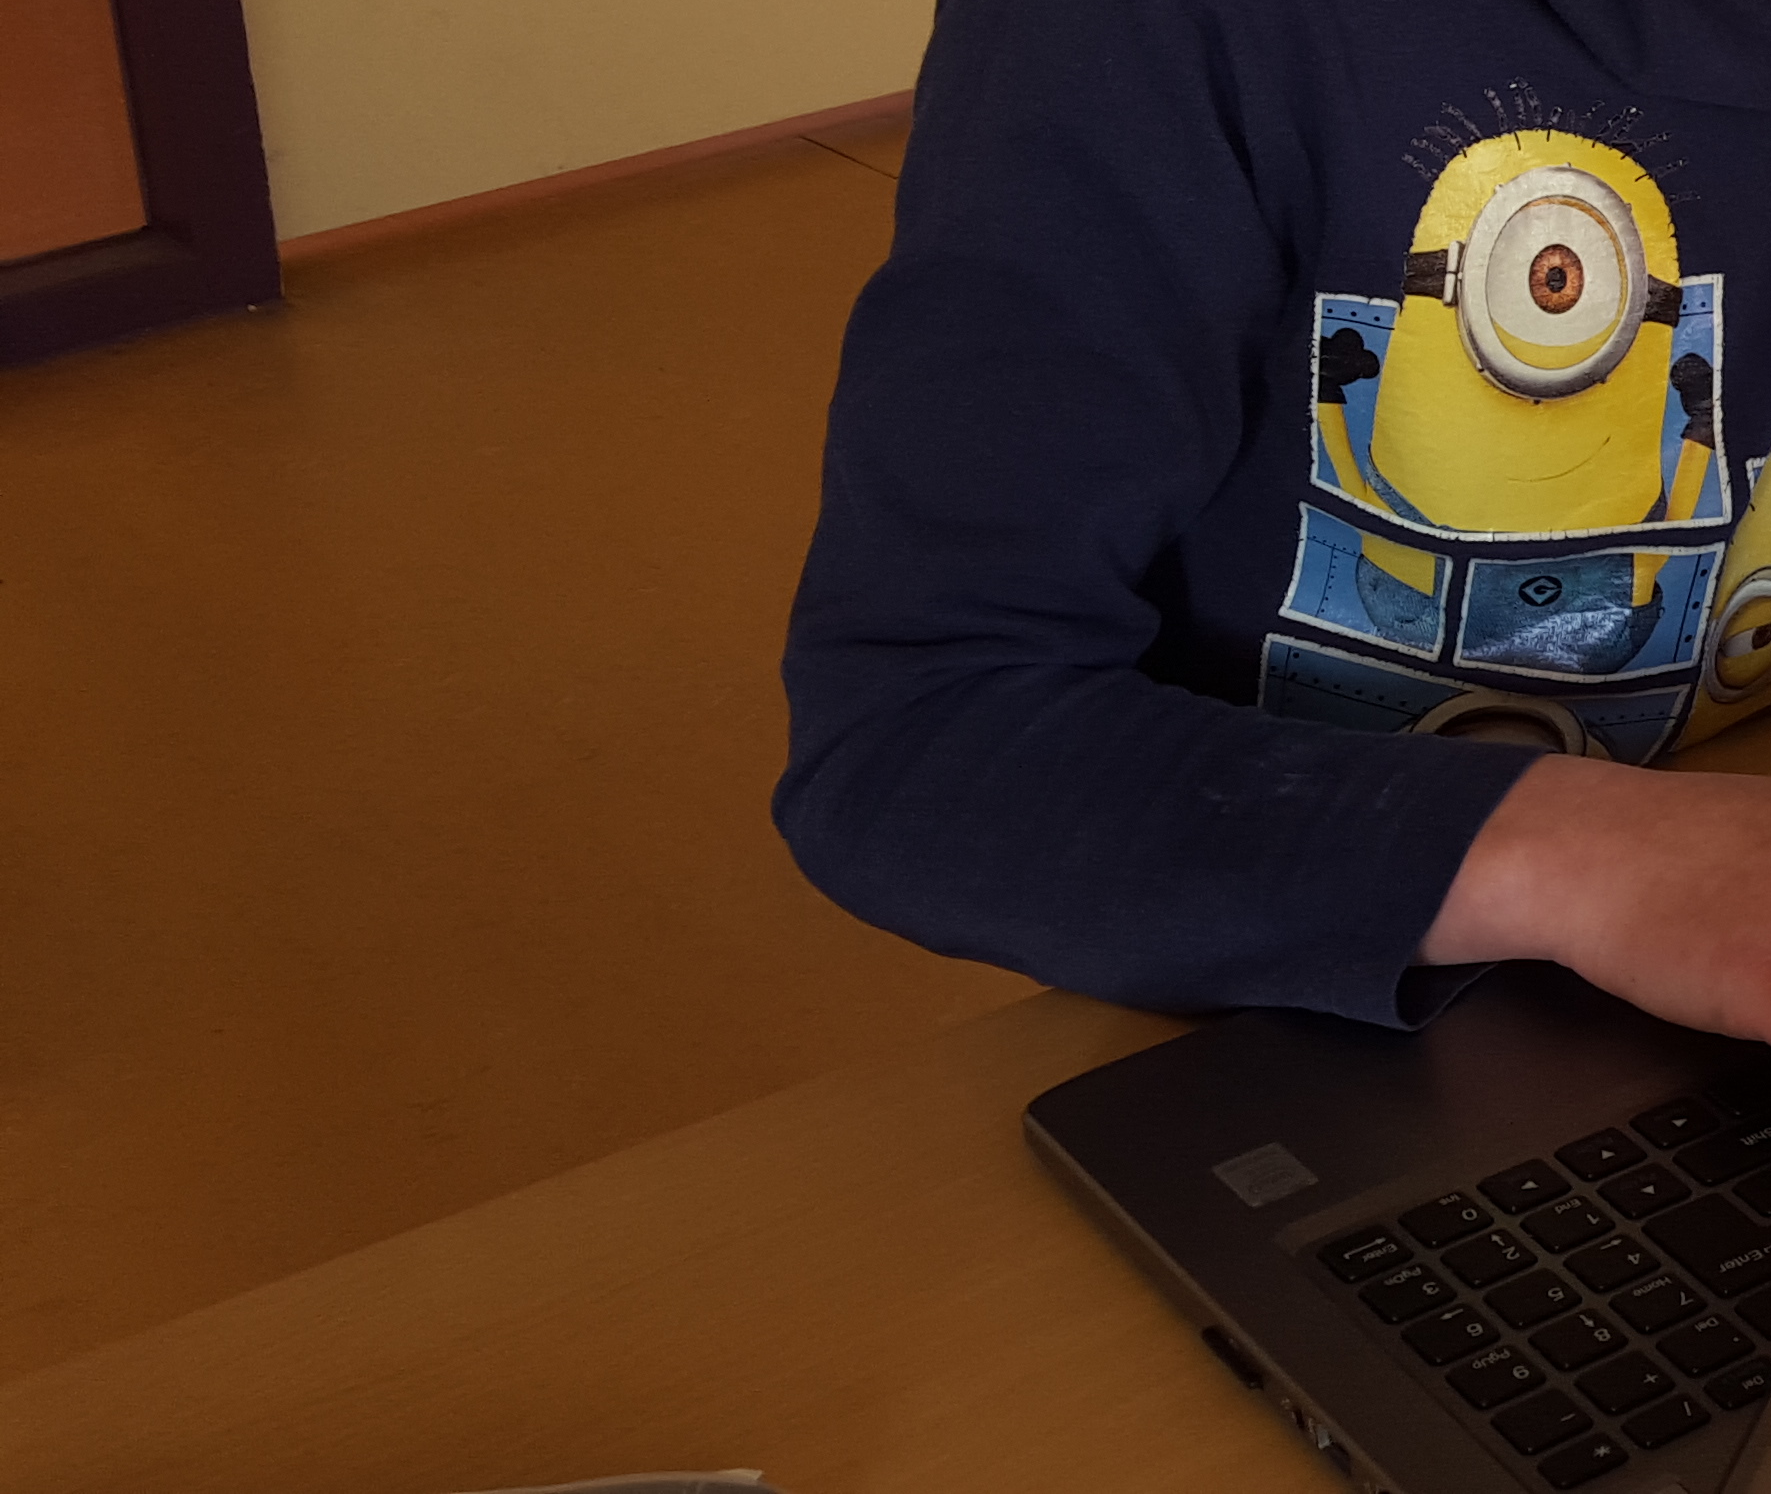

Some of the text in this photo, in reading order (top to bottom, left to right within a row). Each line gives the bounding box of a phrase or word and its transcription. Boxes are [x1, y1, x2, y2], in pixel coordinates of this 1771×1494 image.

[1440, 1192, 1461, 1206] Ins
[1555, 1199, 1581, 1214] End
[1462, 1209, 1477, 1220] 0
[1587, 1214, 1599, 1224] 1
[1362, 1243, 1398, 1262] Enter
[1502, 1246, 1519, 1259] 2
[1628, 1254, 1640, 1264] 4
[1720, 1250, 1763, 1272] Enter
[1386, 1269, 1422, 1286] PgDn
[1423, 1282, 1439, 1294] 3
[1633, 1277, 1671, 1296] Home
[1548, 1288, 1564, 1301] 5
[1681, 1292, 1693, 1305] 7
[1467, 1323, 1483, 1336] 6
[1695, 1317, 1719, 1331] Del
[1594, 1329, 1610, 1341] 8
[1473, 1349, 1510, 1368] PgUp
[1513, 1366, 1529, 1379] 9
[1742, 1376, 1764, 1389] Del
